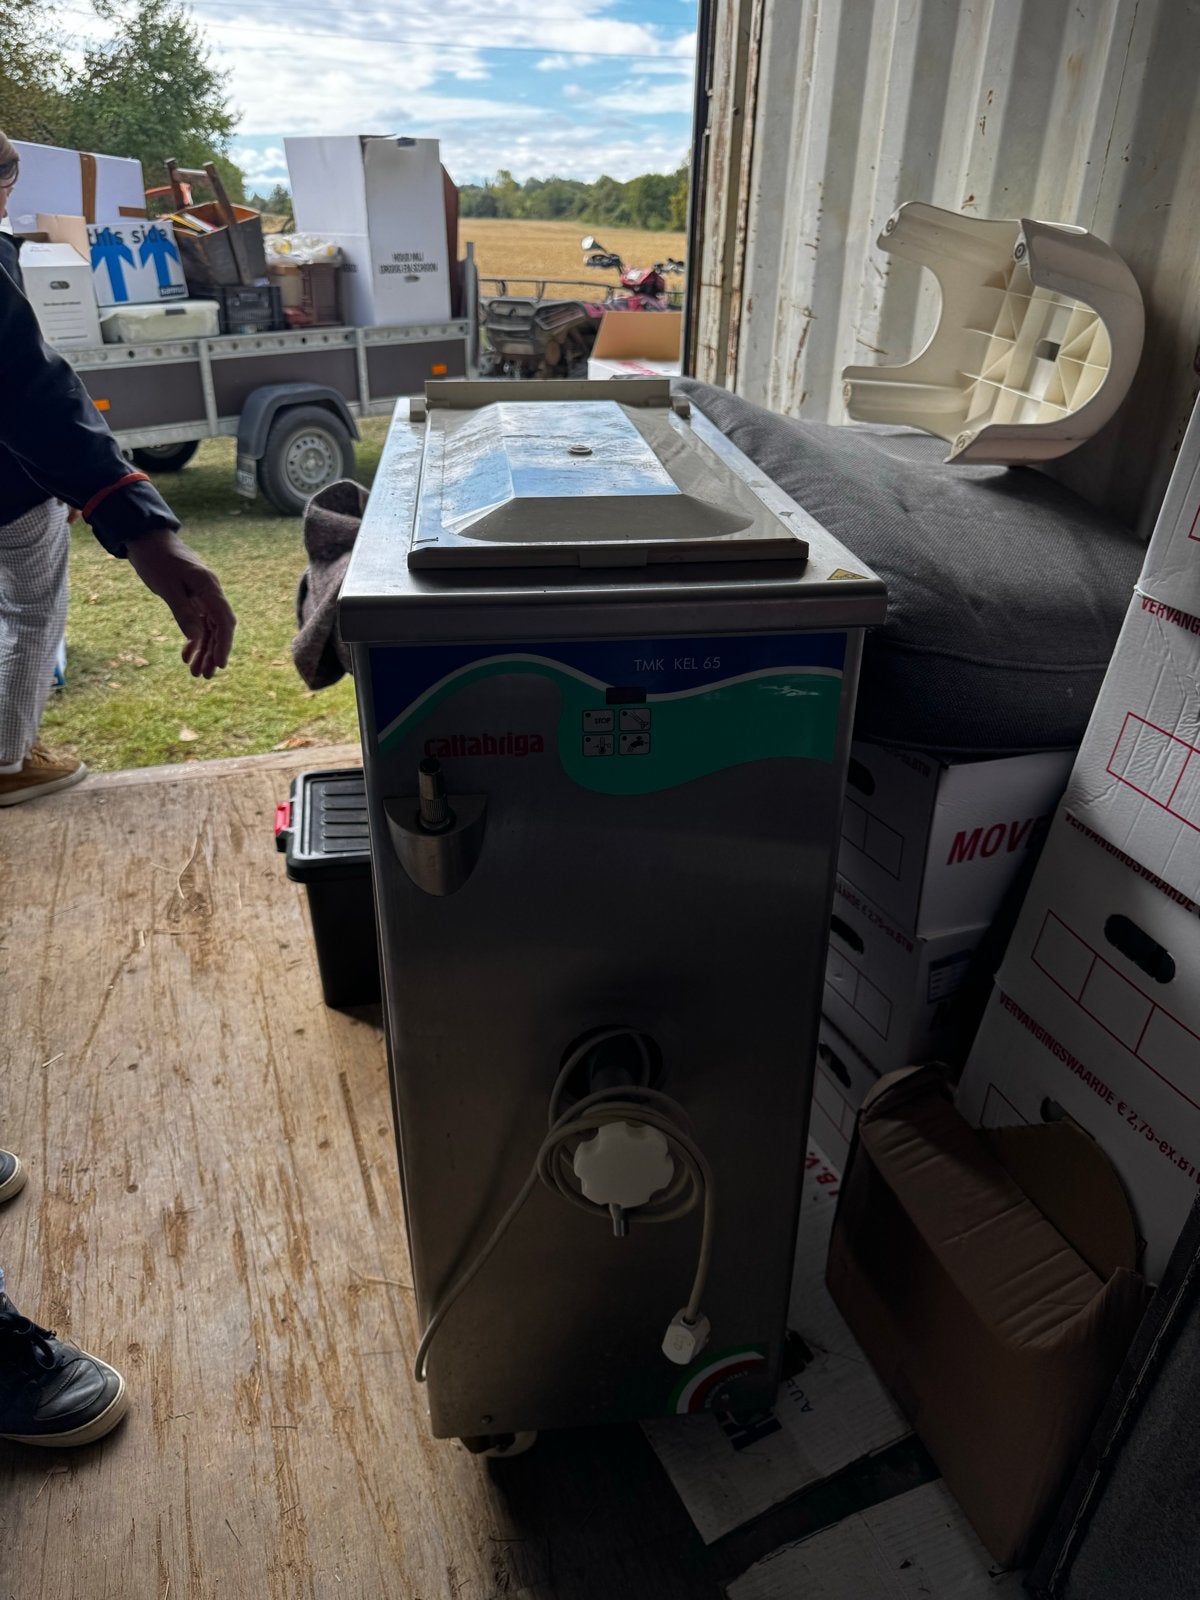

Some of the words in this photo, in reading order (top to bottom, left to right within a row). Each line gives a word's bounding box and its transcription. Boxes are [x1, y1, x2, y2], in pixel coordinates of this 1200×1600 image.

[131, 225, 167, 244] side
[1142, 597, 1200, 636] VERVANG
[633, 658, 665, 672] TMK
[674, 657, 699, 671] KEL
[703, 656, 721, 669] 65
[1000, 990, 1116, 1105] VERVANGINGSWAARDE
